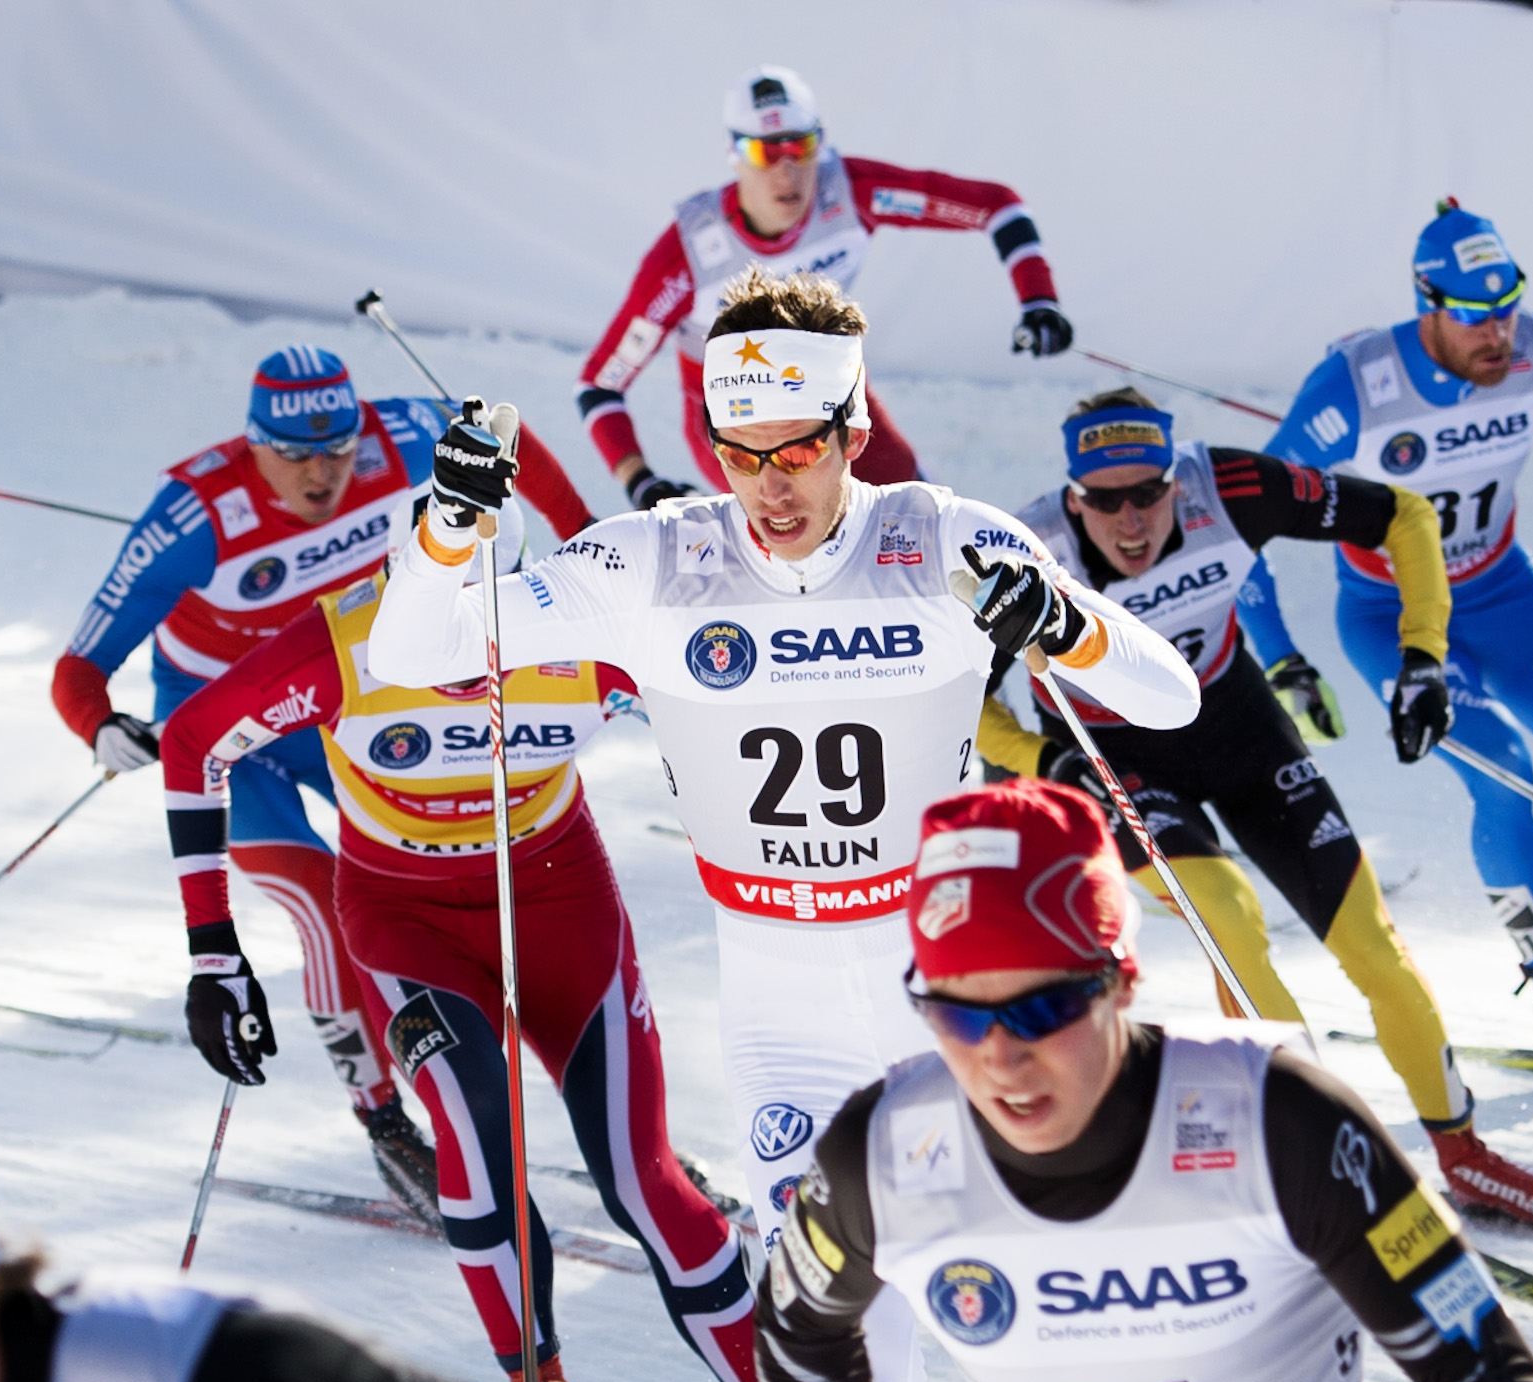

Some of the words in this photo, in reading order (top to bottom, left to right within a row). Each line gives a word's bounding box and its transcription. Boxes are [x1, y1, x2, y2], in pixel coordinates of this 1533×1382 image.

[271, 388, 355, 418] LUKOIL
[1435, 412, 1529, 453] SAAB
[295, 513, 390, 571] SAAB
[1444, 537, 1488, 559] LUN
[98, 520, 178, 610] LUKOIL
[1121, 561, 1228, 616] SAAB
[703, 626, 740, 640] SAAB
[770, 624, 924, 664] SAAB
[770, 669, 830, 683] Defence
[834, 668, 861, 680] and
[865, 663, 926, 679] Security
[443, 724, 575, 751] SAAB
[661, 755, 679, 798] 9
[739, 722, 886, 828] 29
[761, 836, 879, 868] FALUN
[734, 873, 911, 920] VIESSMANN
[1036, 1258, 1248, 1316] SAAB
[1037, 1325, 1122, 1343] Defence
[1126, 1321, 1167, 1337] and
[1171, 1302, 1258, 1334] Security
